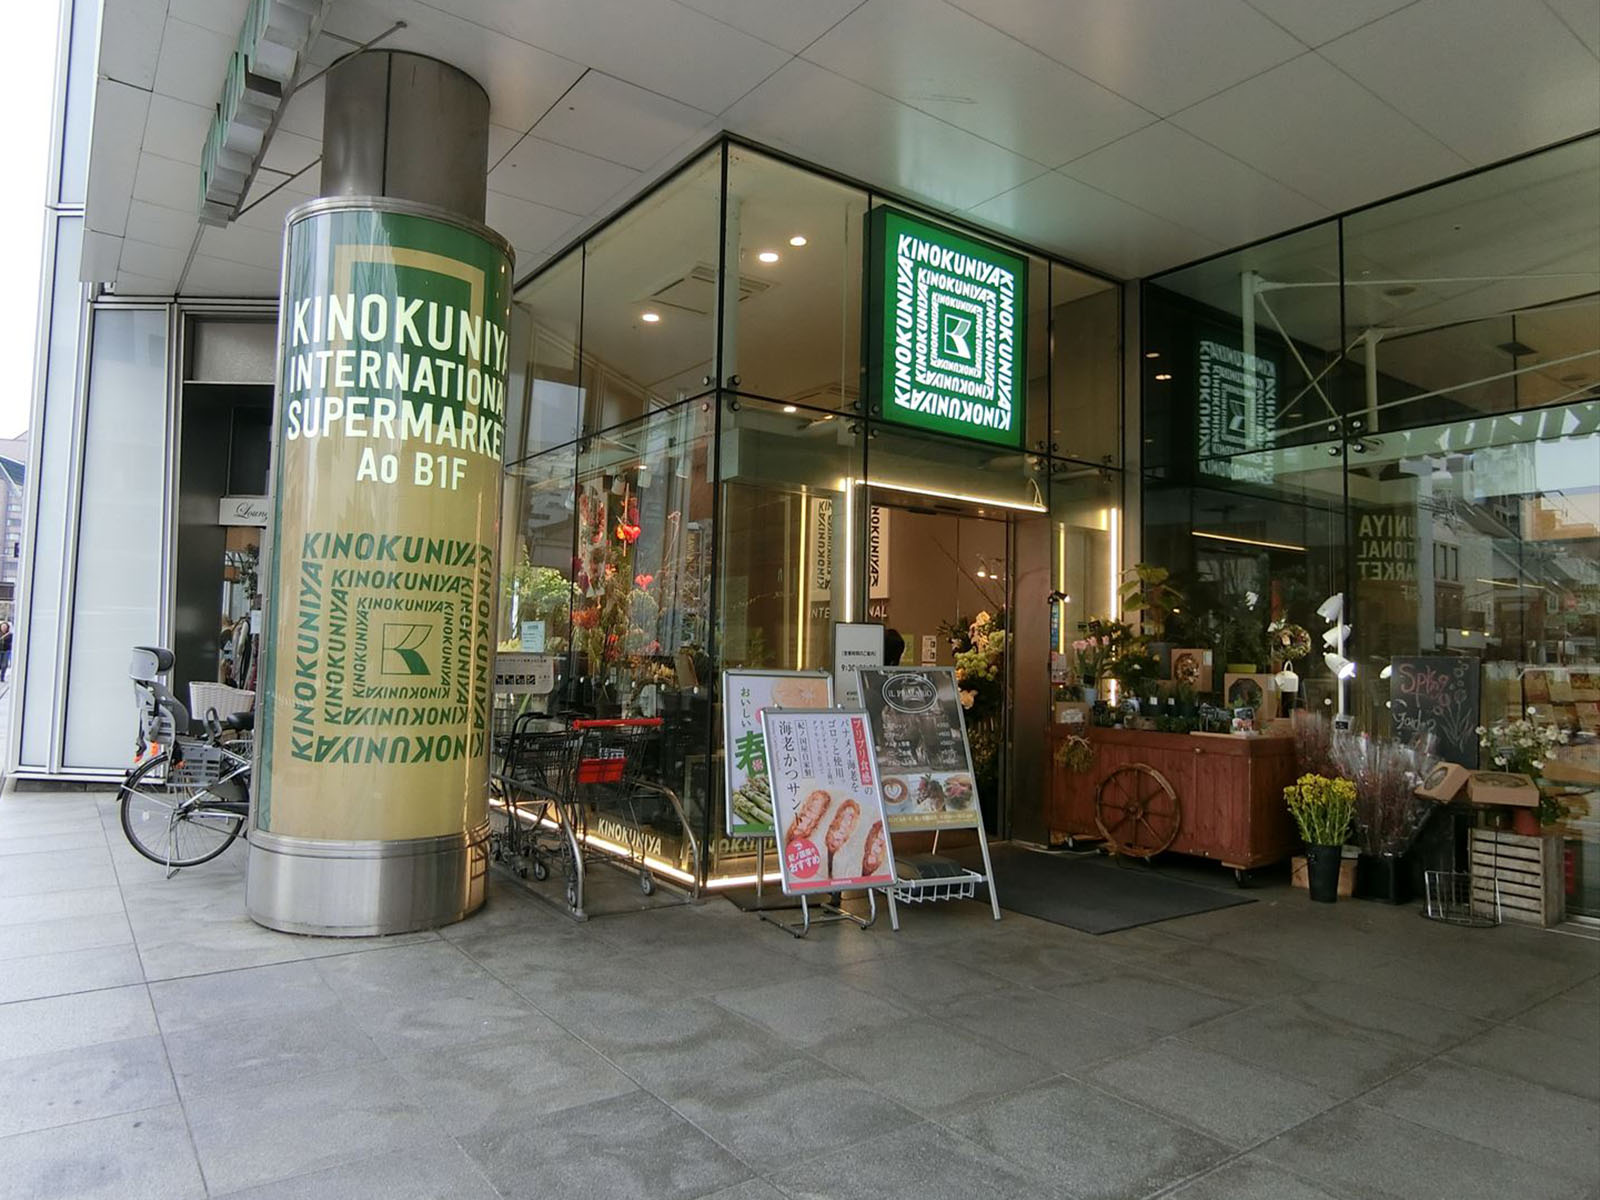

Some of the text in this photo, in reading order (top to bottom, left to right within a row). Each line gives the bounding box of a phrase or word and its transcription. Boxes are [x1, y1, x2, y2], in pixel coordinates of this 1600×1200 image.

[898, 234, 1001, 287] KINOKUNIYA
[918, 267, 990, 302] KINOKUNIYA
[895, 256, 914, 409] KINOKUNIYA
[915, 281, 928, 384] KINOKUNIYA
[985, 289, 996, 391] KINOKUNIYA
[998, 269, 1014, 411] KINOKUNIYA
[925, 371, 995, 401] KINOKUNIYA
[910, 389, 1012, 431] KINOKUNIYA
[357, 448, 468, 490] Ao B1F
[302, 532, 479, 568] KINOKUNIYA
[817, 511, 826, 589] KINOKUNIYA
[331, 569, 463, 594] KINOKUNIYA
[357, 596, 446, 613] KINOKUNIYA
[291, 561, 323, 762] KINOKUNIYA
[324, 589, 348, 725] KINOKUNIYA
[352, 608, 370, 699] KINOKUNIYA
[440, 601, 454, 688] KINOKUNIYA
[456, 577, 474, 706] KINOKUNIYA
[472, 545, 492, 731] KINOKUNIYA
[343, 705, 470, 726] KINOKUNIYA
[365, 686, 451, 699] KINOKUNIYA
[740, 688, 751, 727] おいしい
[314, 730, 485, 764] KINOKUNIYA
[779, 720, 803, 826] 海老かつサンド
[597, 818, 662, 855] KINOKUNIYA
[788, 855, 820, 873] おすすめ
